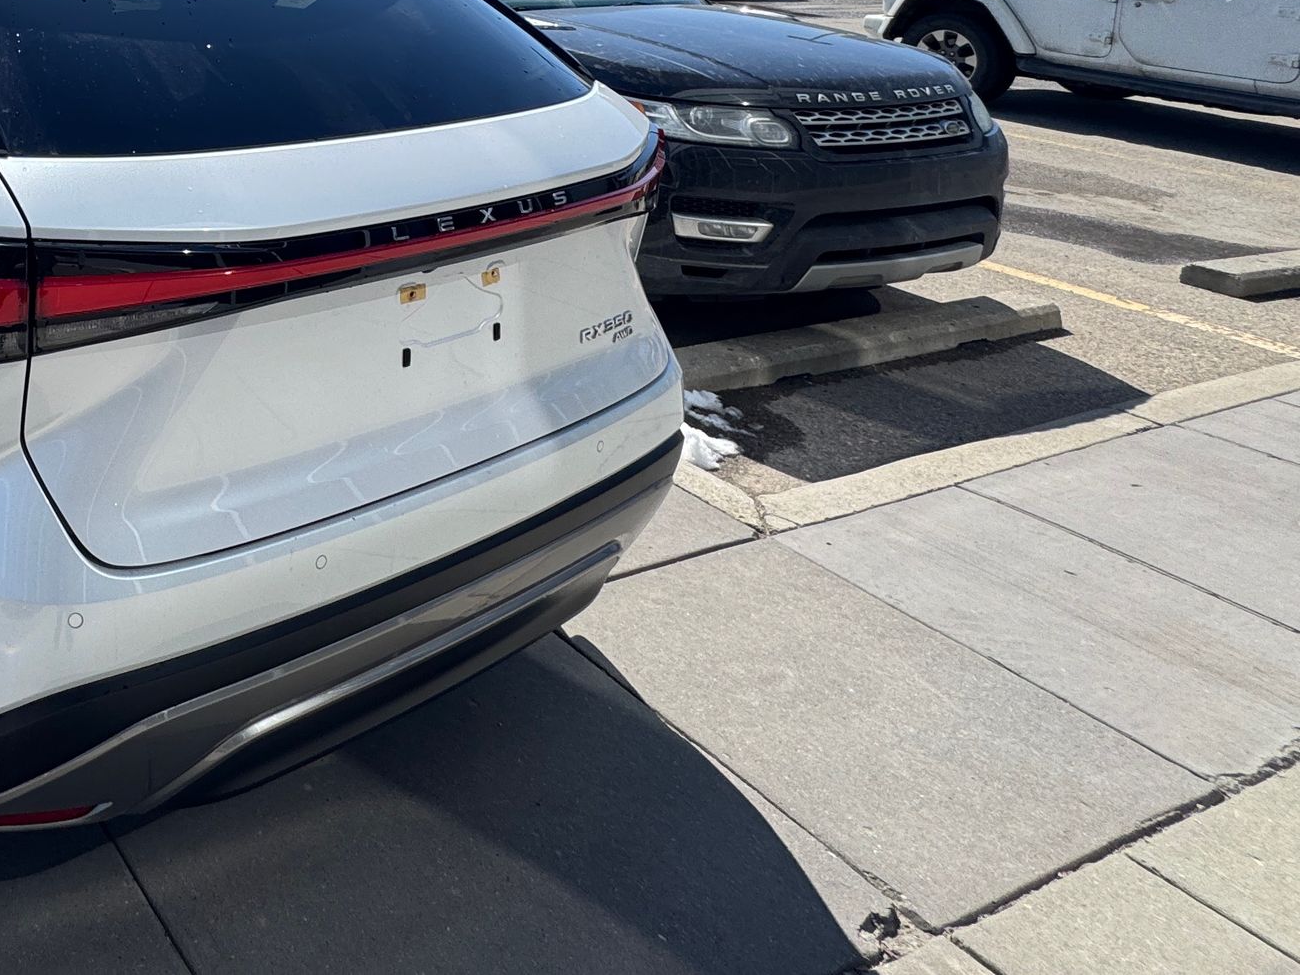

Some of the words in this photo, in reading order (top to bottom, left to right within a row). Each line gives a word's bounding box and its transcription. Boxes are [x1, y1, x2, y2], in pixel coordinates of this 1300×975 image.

[795, 91, 882, 104] RANGE
[893, 84, 956, 100] ROVER
[392, 190, 568, 241] LEXUS
